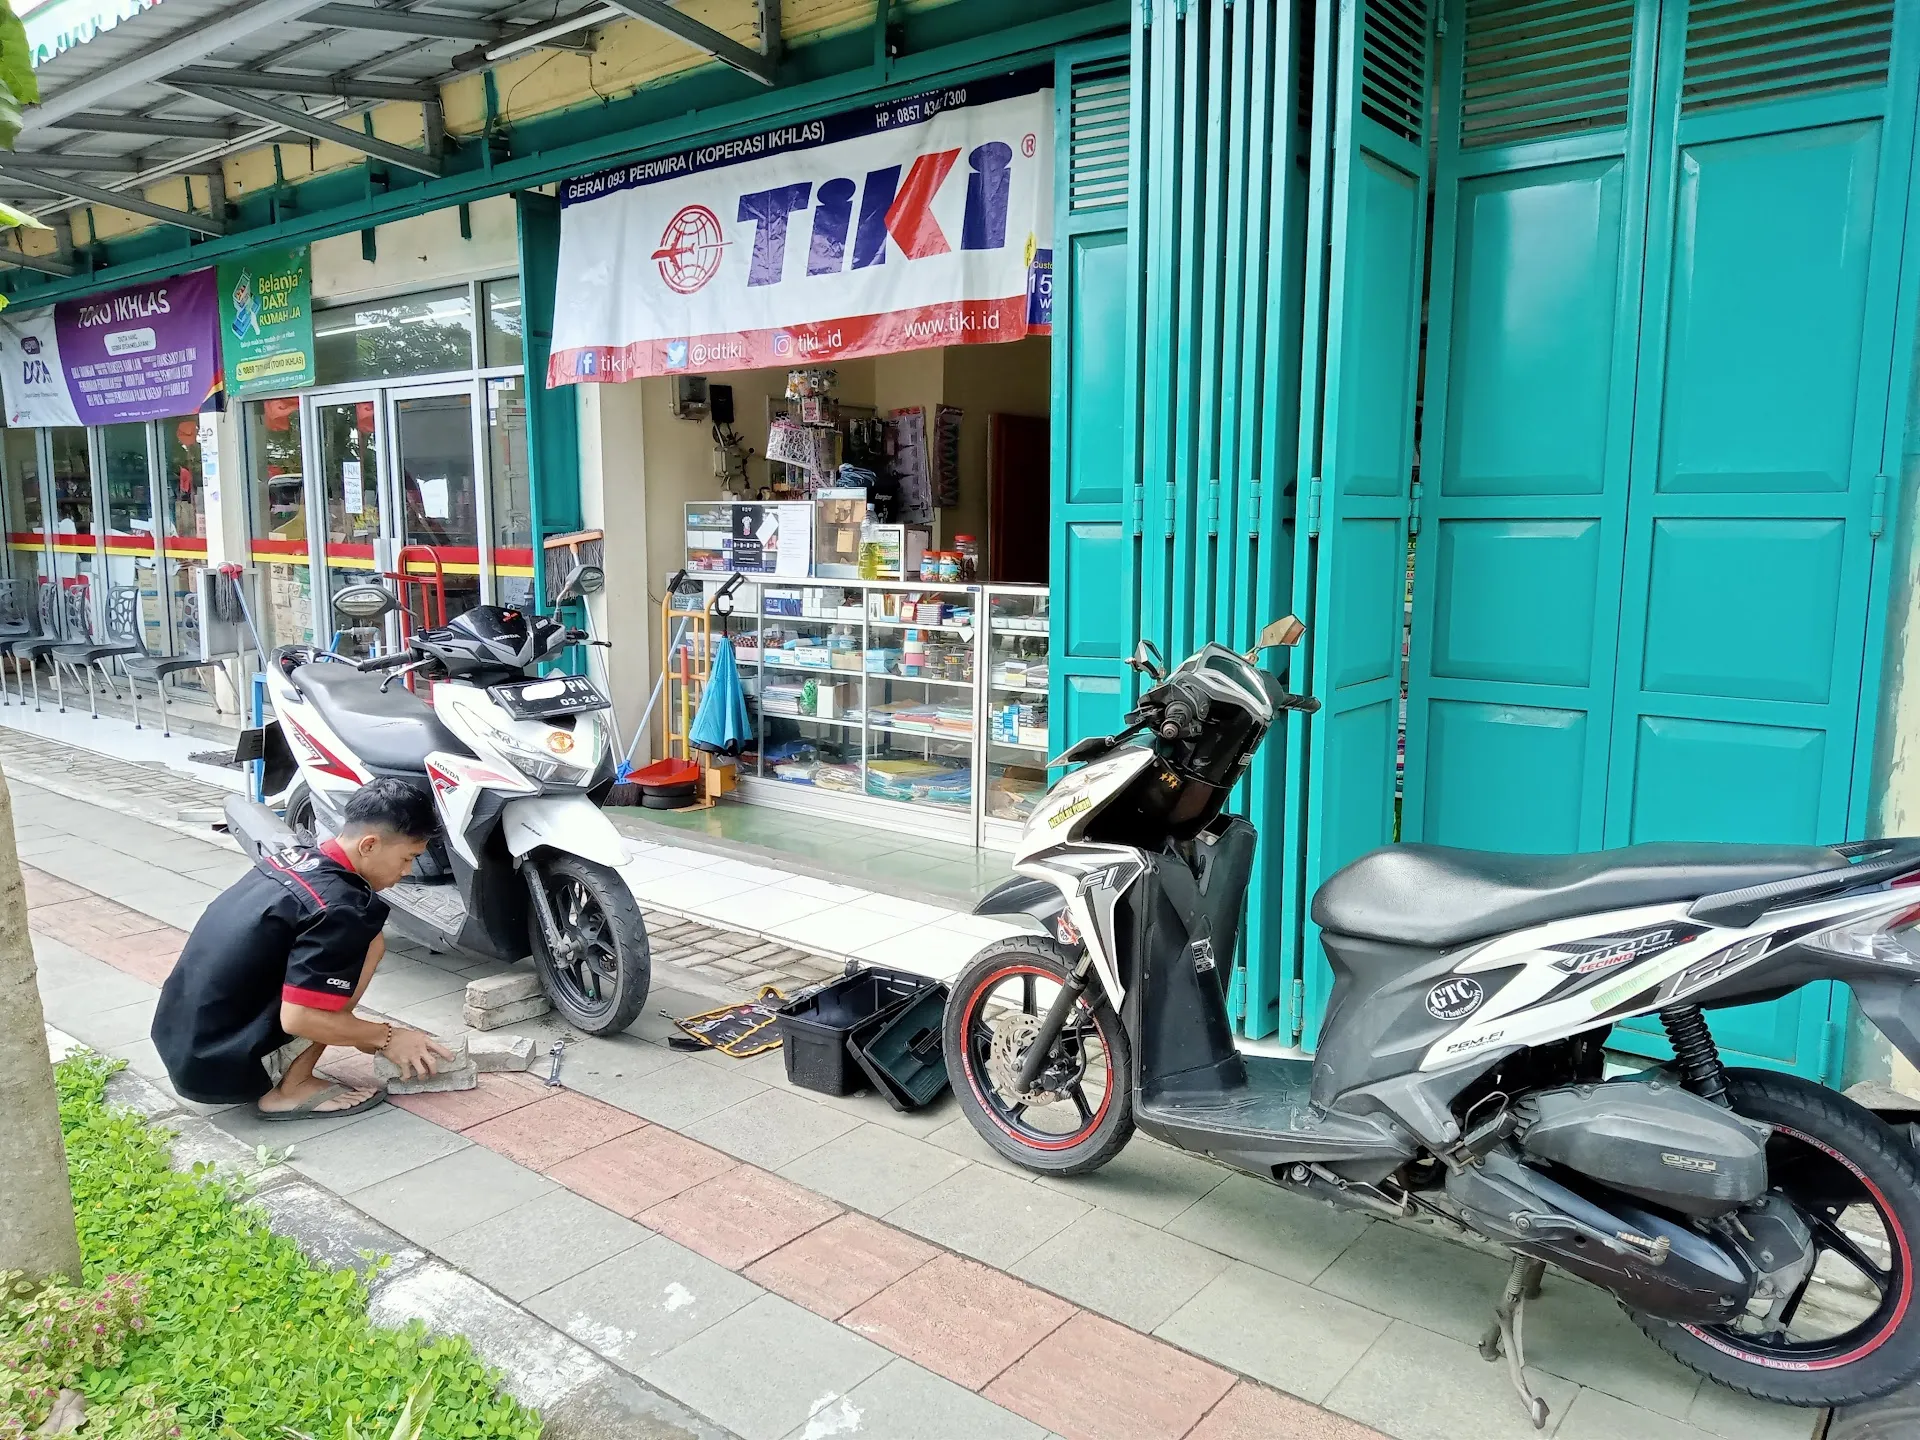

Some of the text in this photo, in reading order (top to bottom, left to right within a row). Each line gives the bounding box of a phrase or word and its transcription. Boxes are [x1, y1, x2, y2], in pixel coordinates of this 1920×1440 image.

[876, 112, 890, 129] HP
[897, 104, 921, 124] 0857
[568, 177, 604, 199] GERAI
[608, 172, 625, 190] 093
[629, 155, 687, 183] PERWIRA
[696, 133, 765, 166] KOPERASI
[768, 120, 825, 148] IKHLAS)
[77, 289, 171, 329] TOKO IKHLAS
[262, 292, 288, 311] DARI
[259, 310, 289, 326] RUMAH
[904, 310, 1000, 338] www.tiki.id
[691, 340, 742, 366] @idtiki
[798, 328, 842, 355] tiki_id
[500, 689, 516, 702] R
[433, 760, 461, 782] HONDA
[1547, 929, 1675, 976] VARIO
[1579, 951, 1635, 974] TECHNO
[1430, 978, 1474, 1010] GTC
[1430, 1006, 1445, 1018] Gang
[1446, 1030, 1505, 1052] PGM-FI
[1785, 1127, 1865, 1181] COMPOSITE SYSTEM
[1700, 1332, 1743, 1360] COMPOSITE
